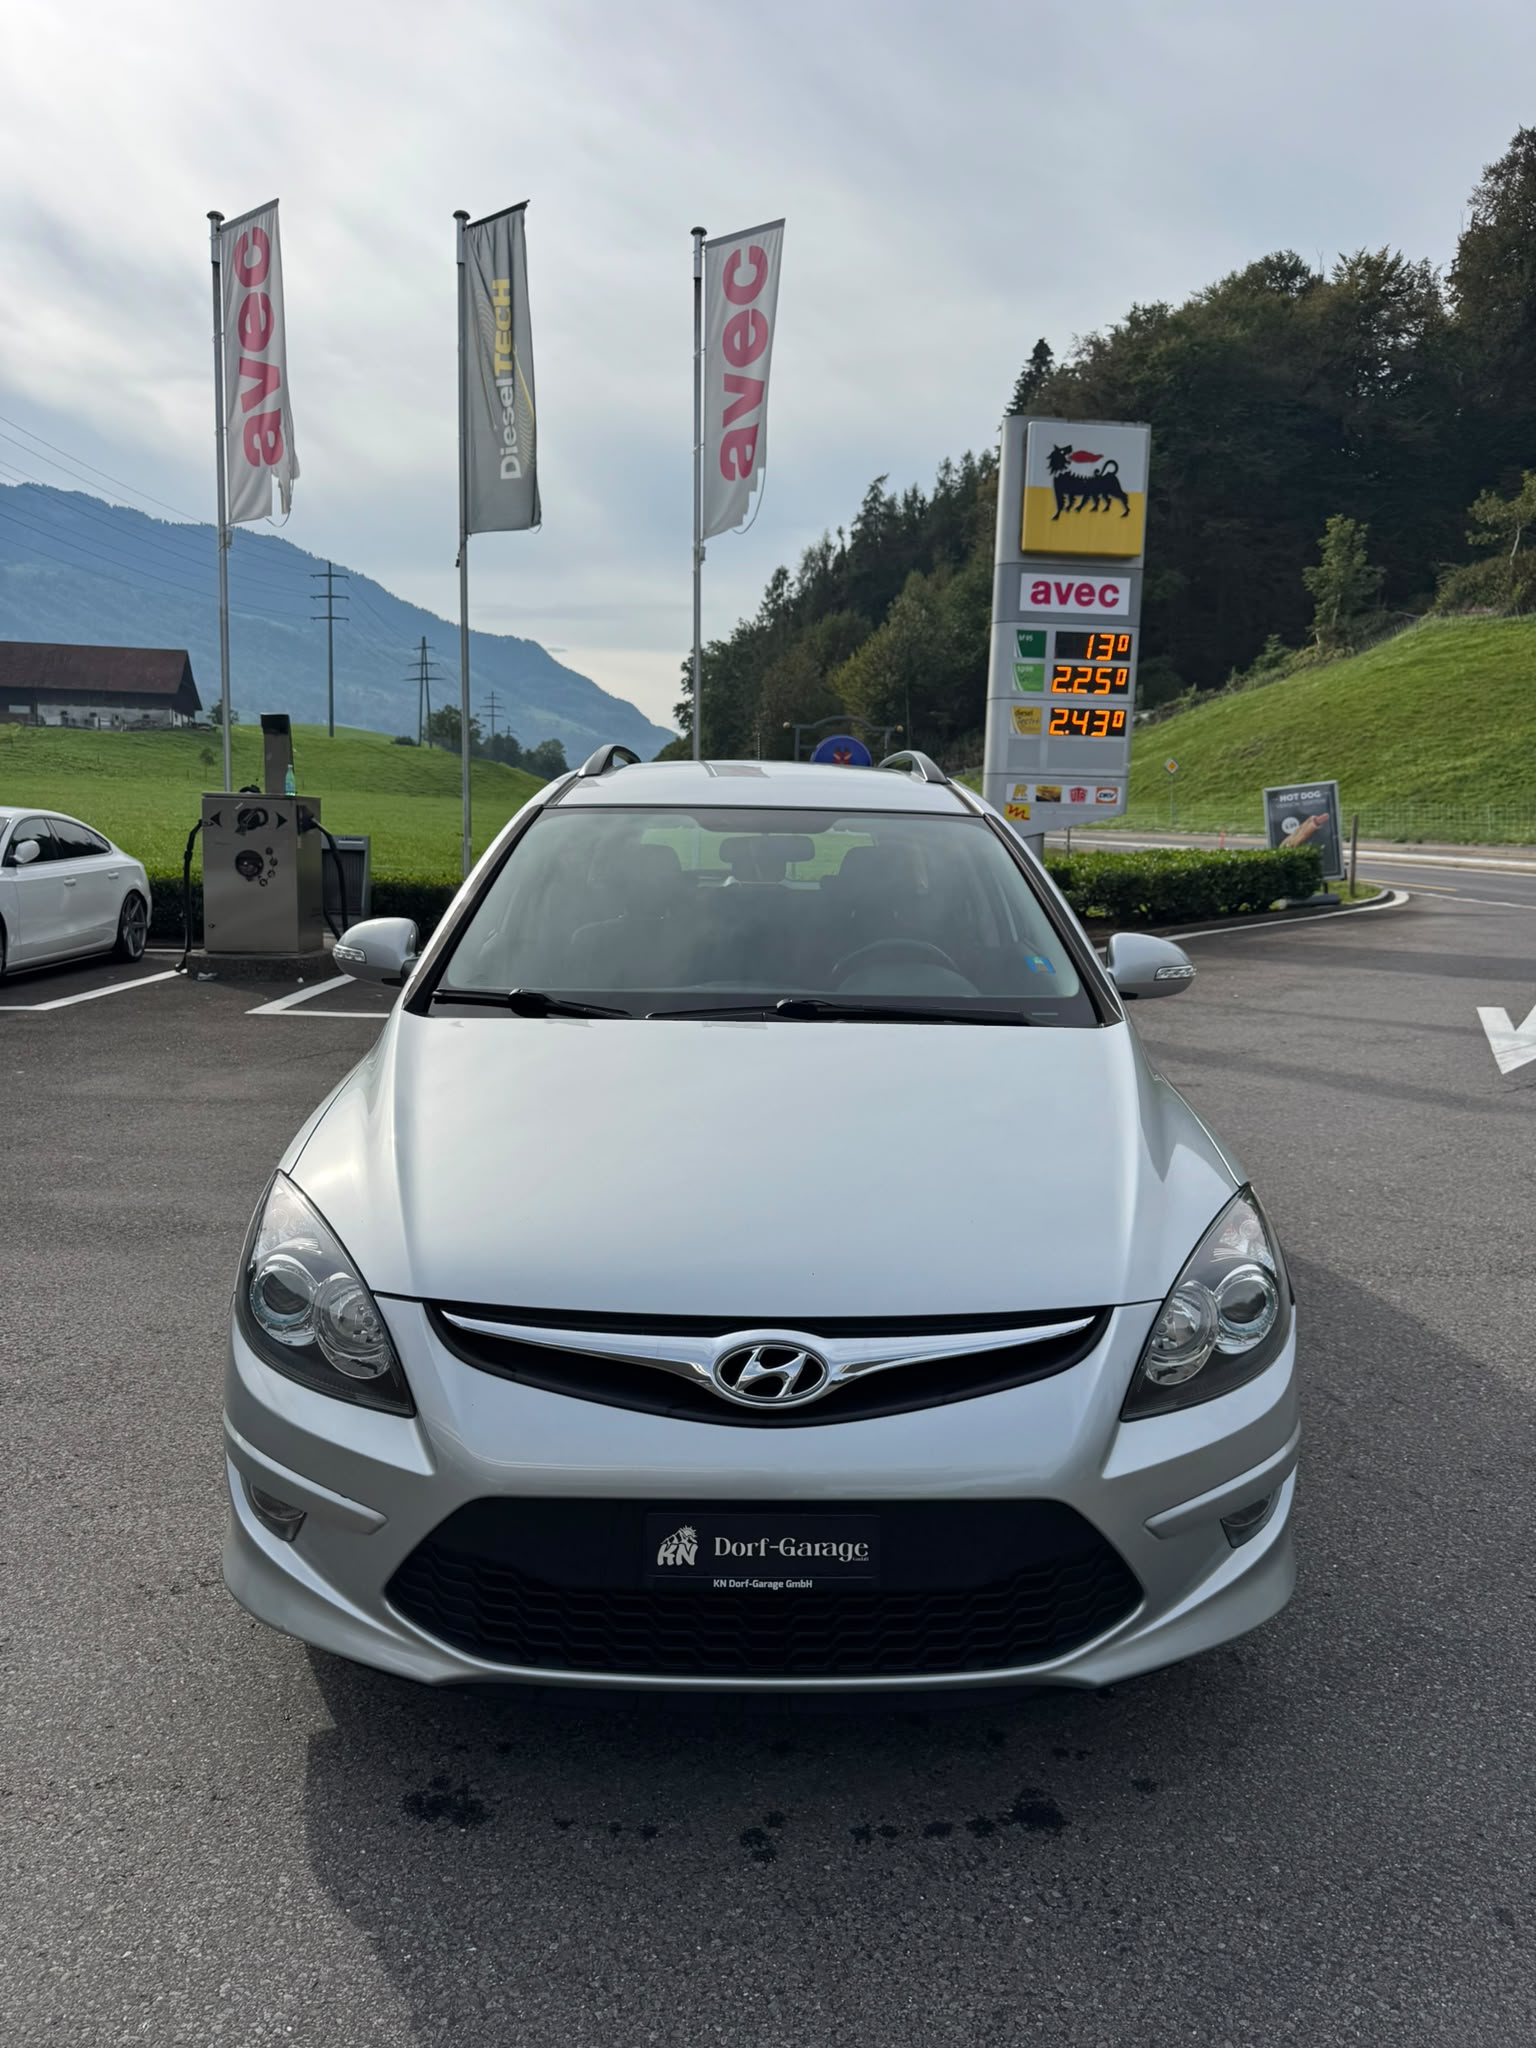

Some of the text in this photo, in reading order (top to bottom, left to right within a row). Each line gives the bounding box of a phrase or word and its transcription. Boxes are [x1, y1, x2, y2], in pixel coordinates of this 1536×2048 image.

[233, 226, 284, 468] avec
[719, 245, 769, 481] avec
[1030, 580, 1120, 608] avec
[1279, 790, 1321, 802] HOT DOG
[657, 1543, 698, 1566] KN
[714, 1536, 869, 1562] Dorf-Garage
[713, 1579, 813, 1590] KN Dorf-Garage GmbH
